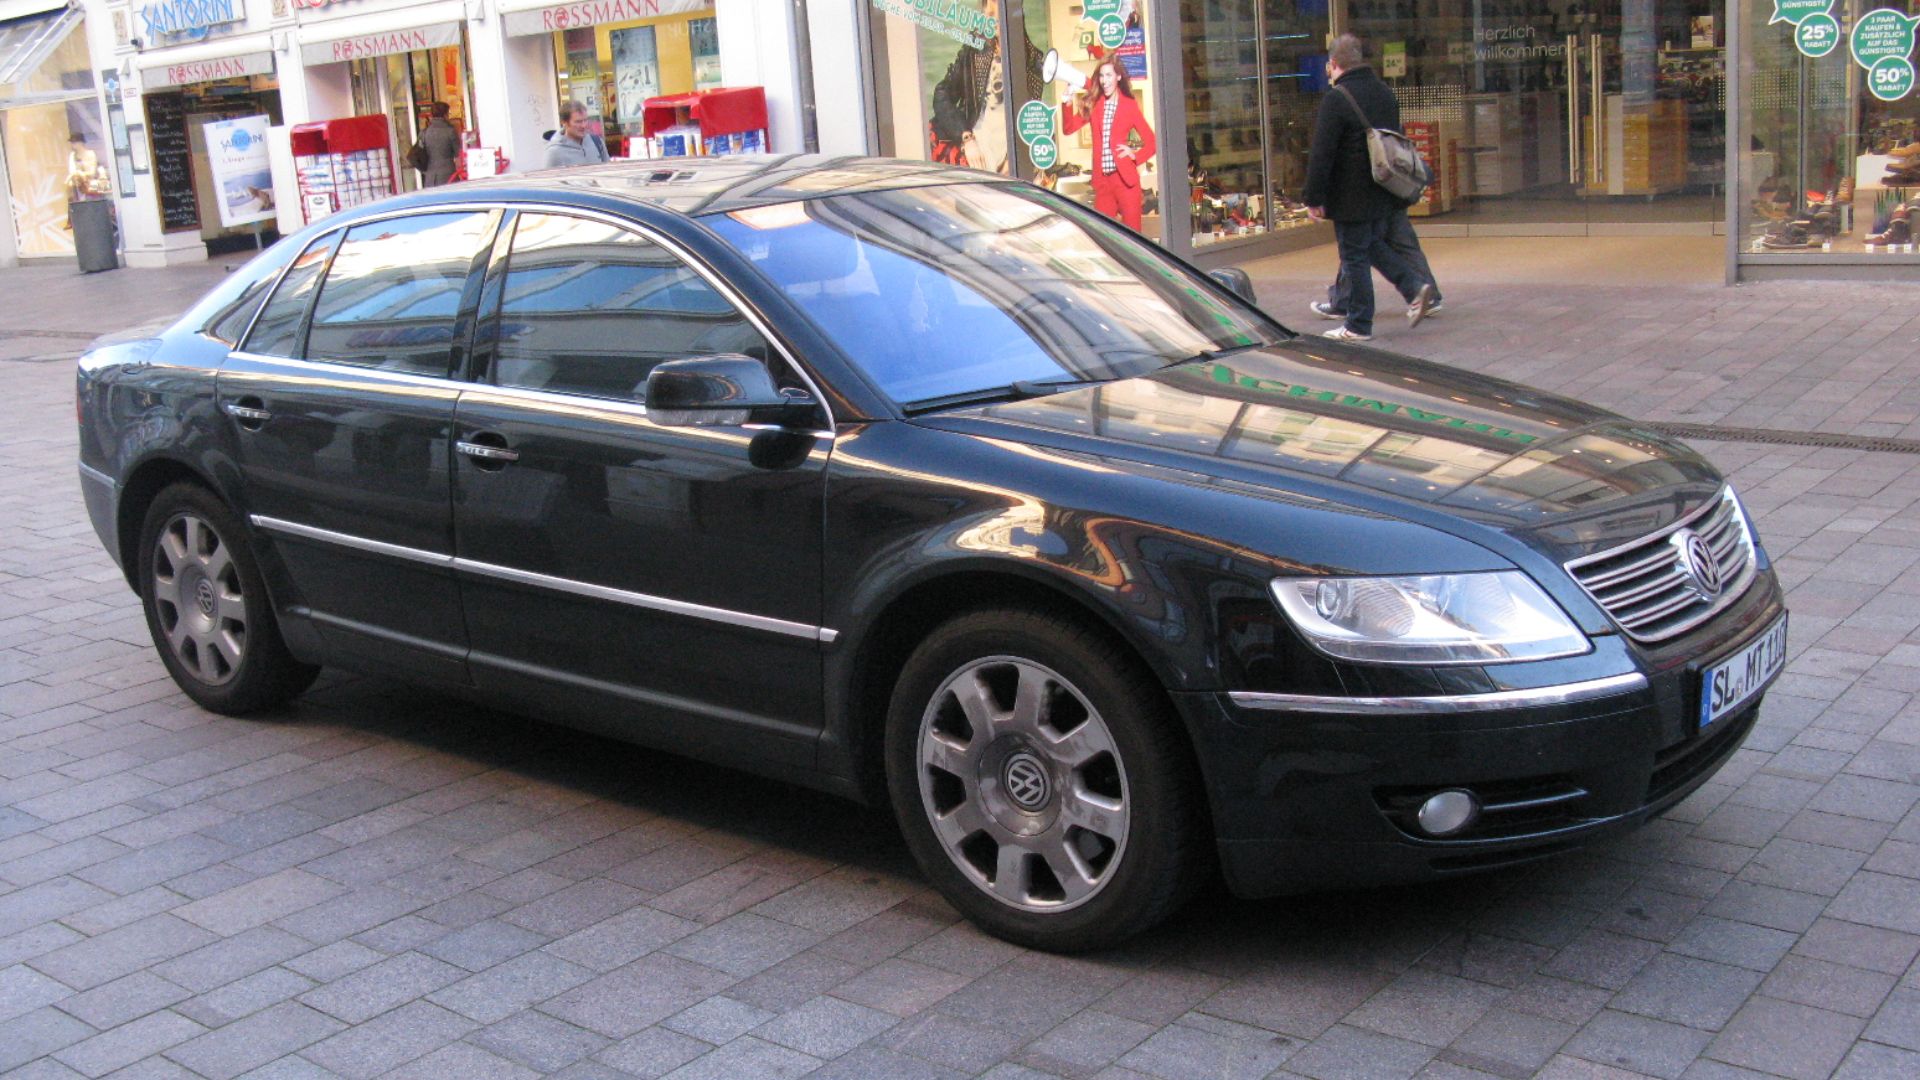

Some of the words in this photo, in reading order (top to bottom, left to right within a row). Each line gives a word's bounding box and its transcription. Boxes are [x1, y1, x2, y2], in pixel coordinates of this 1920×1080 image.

[141, 0, 233, 46] SANTORINI
[543, 0, 660, 30] ROSSMANN
[1474, 25, 1535, 41] Herzlich
[1802, 24, 1833, 40] 25%
[333, 30, 427, 61] ROSSMANN
[1475, 43, 1567, 60] willkommen
[168, 58, 245, 84] ROSSMANN
[1875, 68, 1909, 83] 50%
[1712, 665, 1735, 713] SL
[1745, 640, 1765, 692] MT
